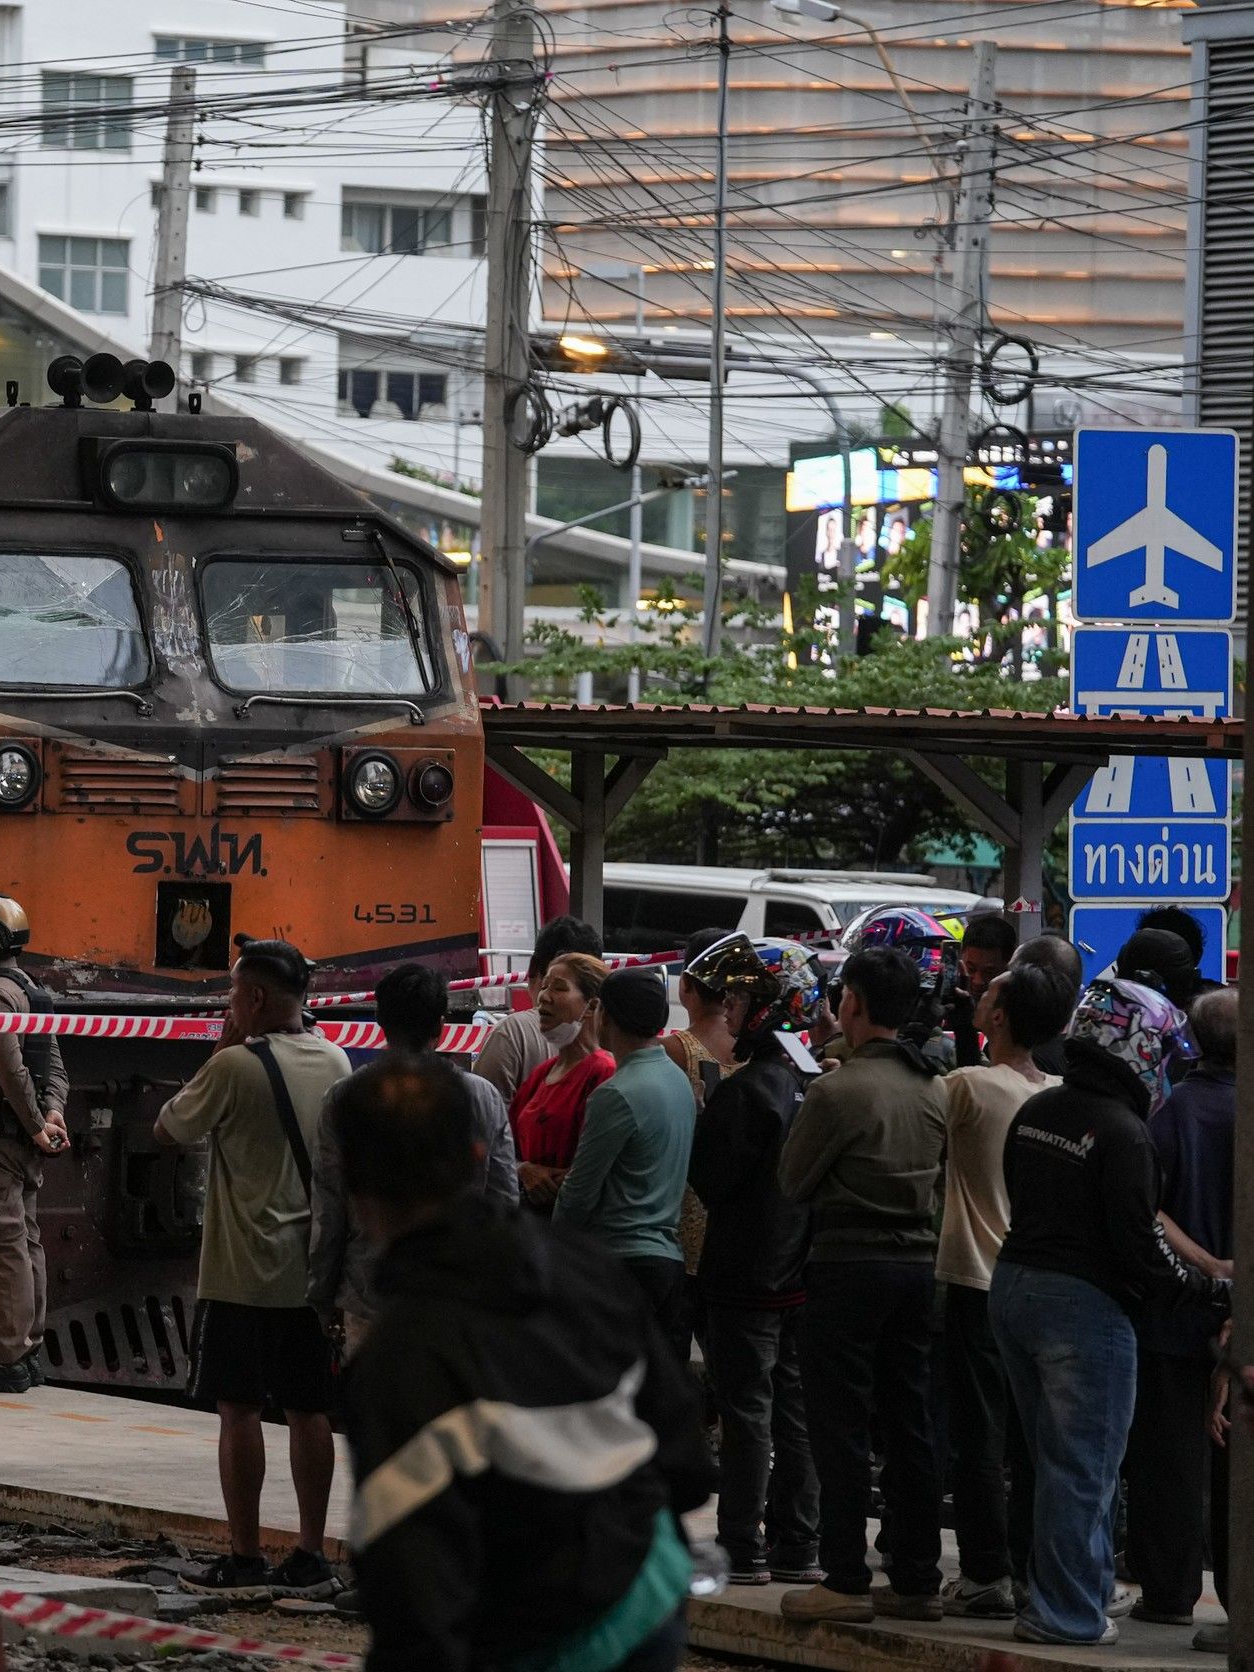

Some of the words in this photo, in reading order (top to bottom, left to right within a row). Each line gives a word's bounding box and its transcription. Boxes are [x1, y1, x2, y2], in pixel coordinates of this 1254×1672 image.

[1083, 826, 1217, 884] ทางด่วน
[353, 903, 437, 924] 4531
